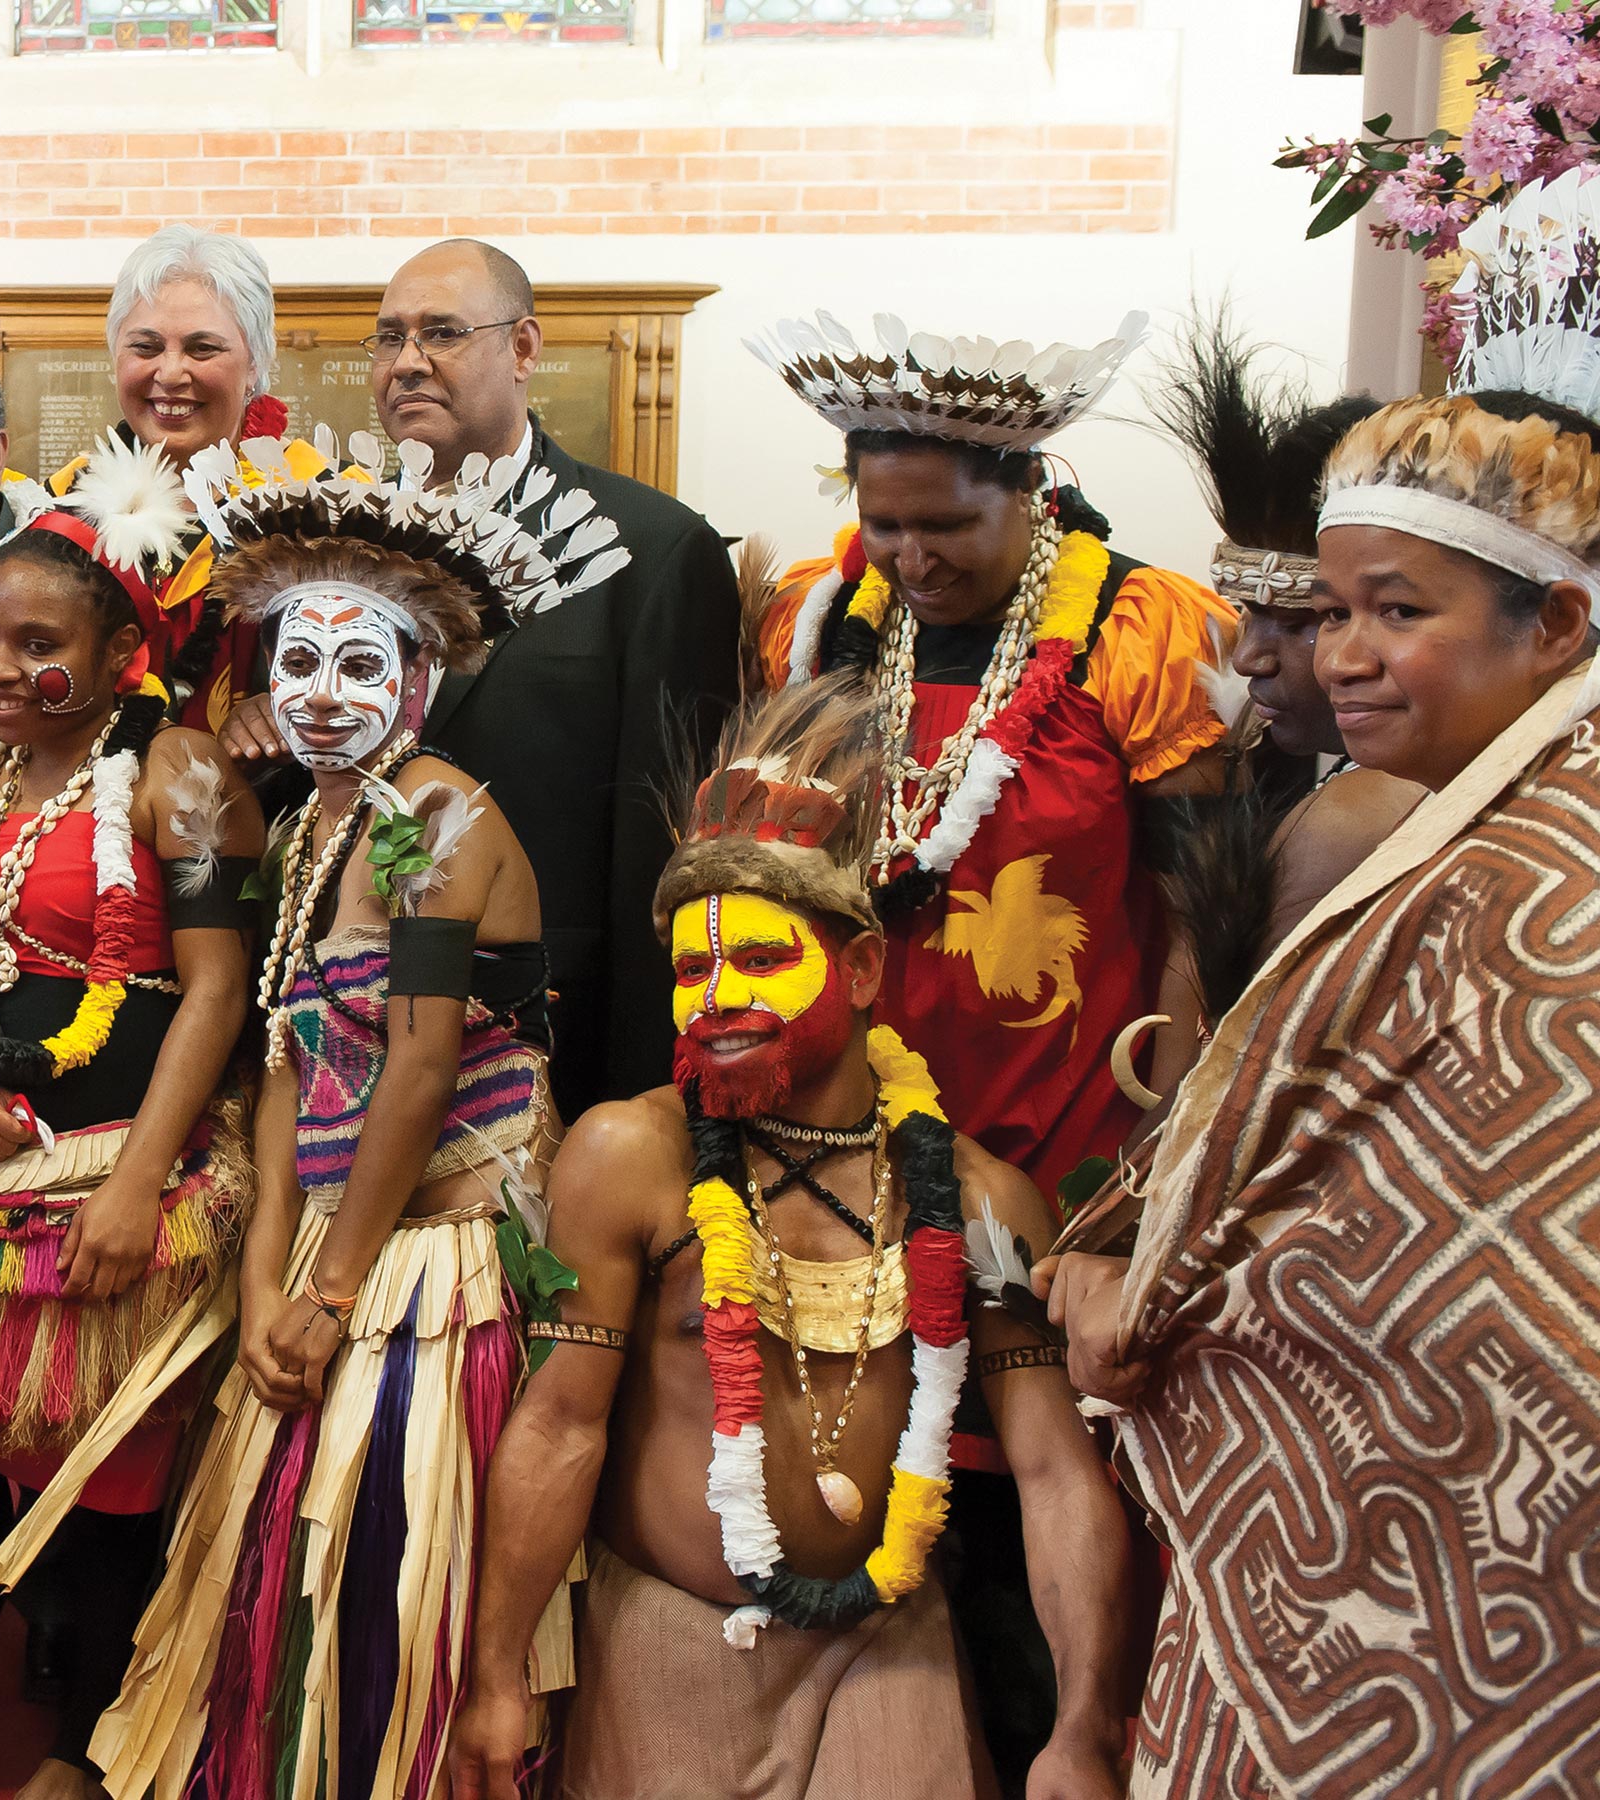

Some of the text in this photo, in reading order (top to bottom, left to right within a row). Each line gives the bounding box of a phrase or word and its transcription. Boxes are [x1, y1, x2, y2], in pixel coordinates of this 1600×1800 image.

[38, 361, 111, 372] INSCRIBED
[322, 361, 341, 372] OF
[321, 374, 367, 385] IN THE
